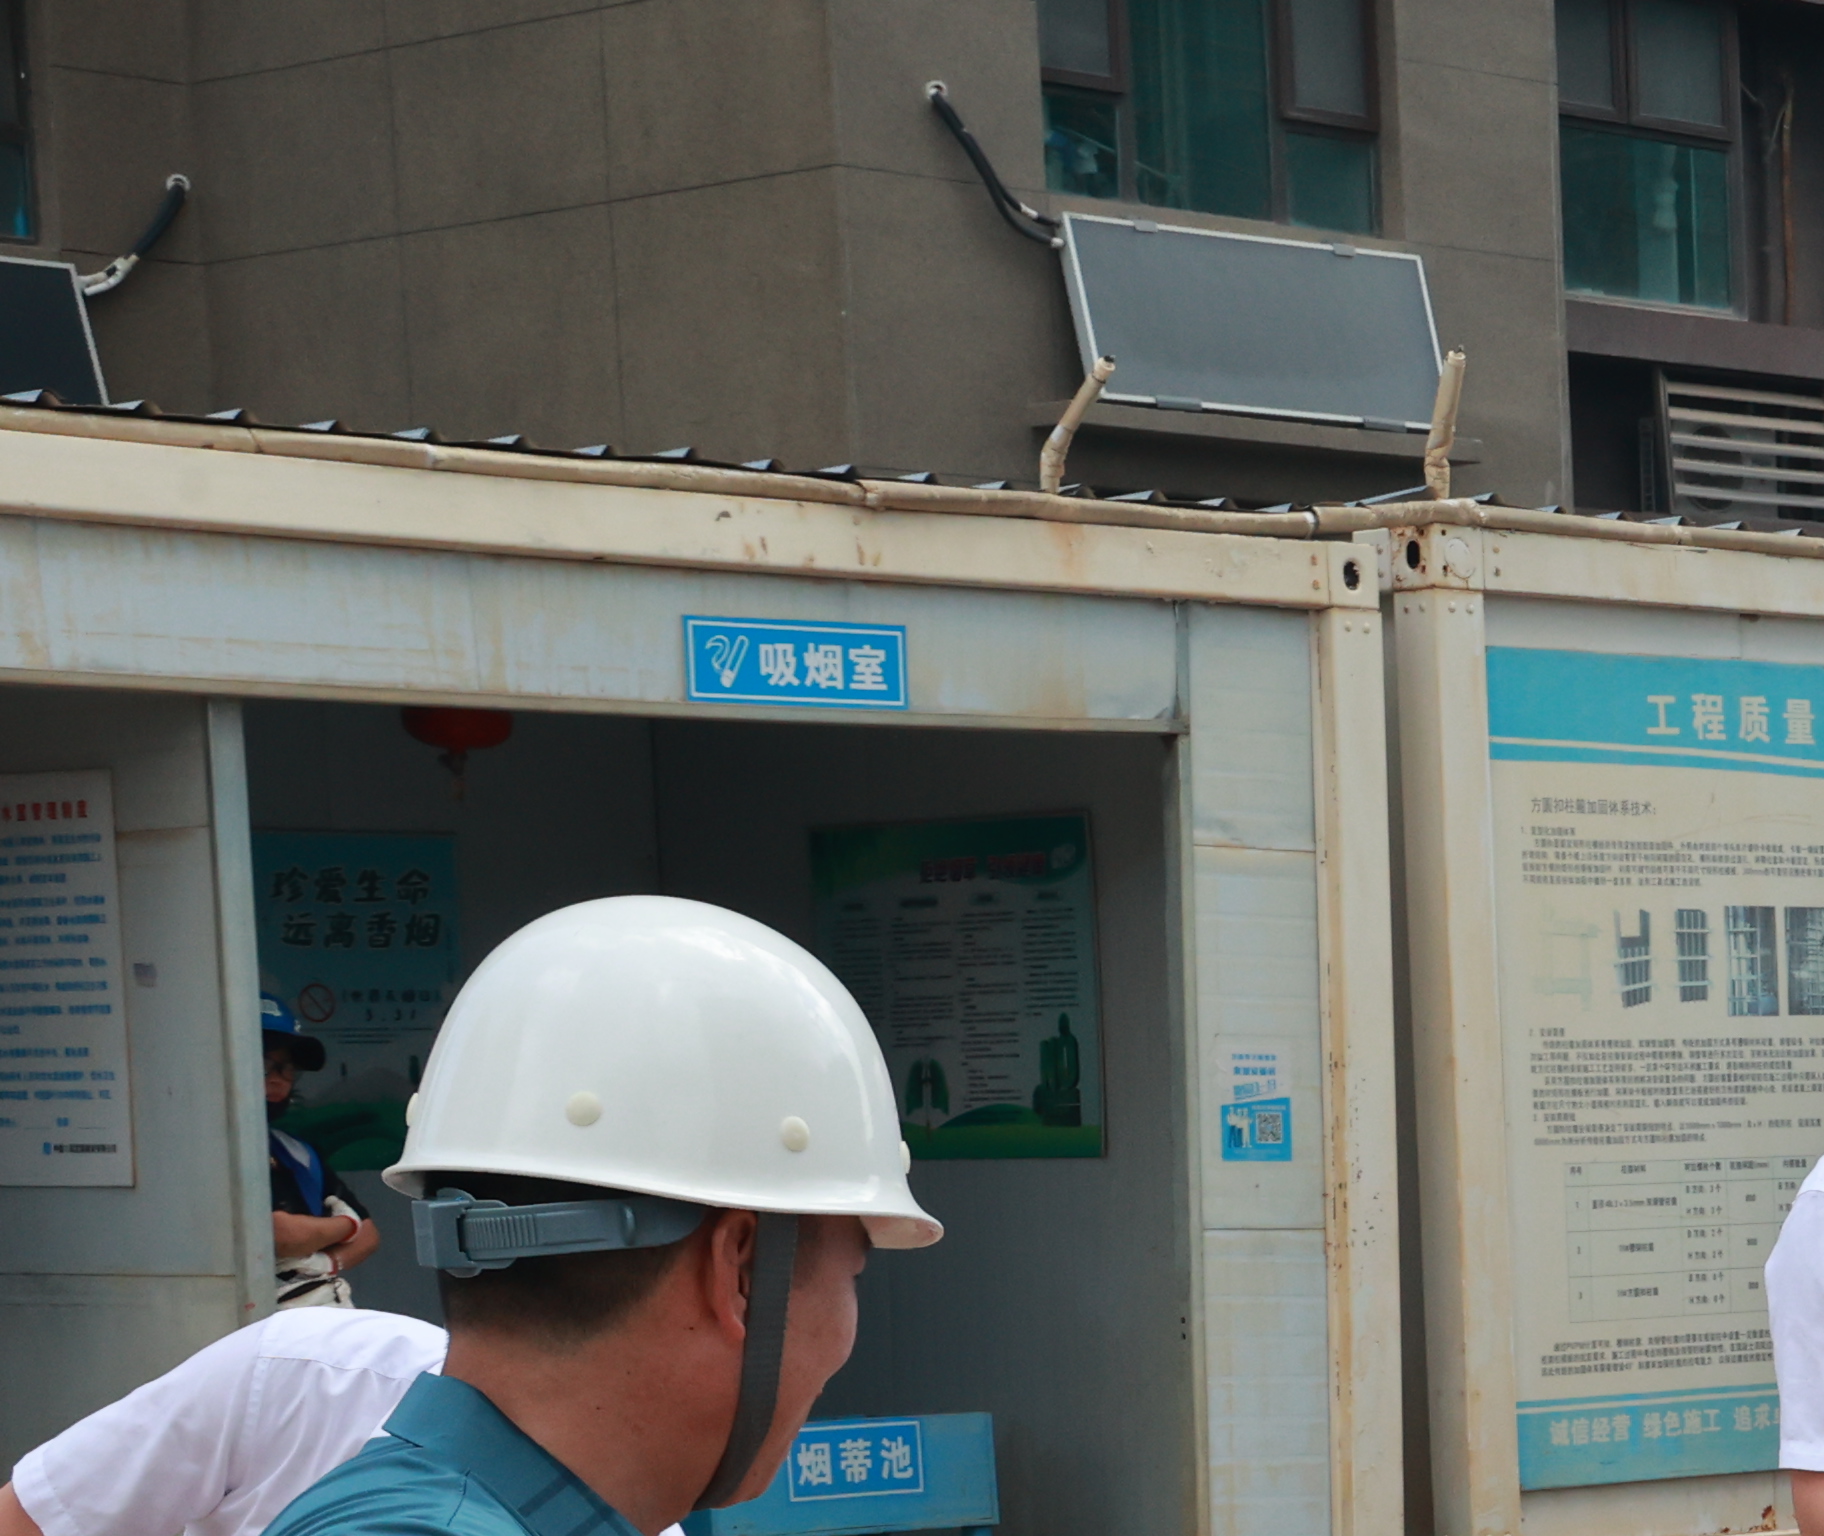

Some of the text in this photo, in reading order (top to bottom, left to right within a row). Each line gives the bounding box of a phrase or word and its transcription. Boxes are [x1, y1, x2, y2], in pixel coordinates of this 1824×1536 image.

[758, 641, 888, 691] 吸烟室
[270, 867, 430, 905] 珍爱生命
[281, 911, 441, 949] 远离香烟
[1551, 1413, 1631, 1446] 诚信经营
[1643, 1409, 1721, 1439] 绿色施工
[797, 1436, 914, 1486] 烟蒂池
